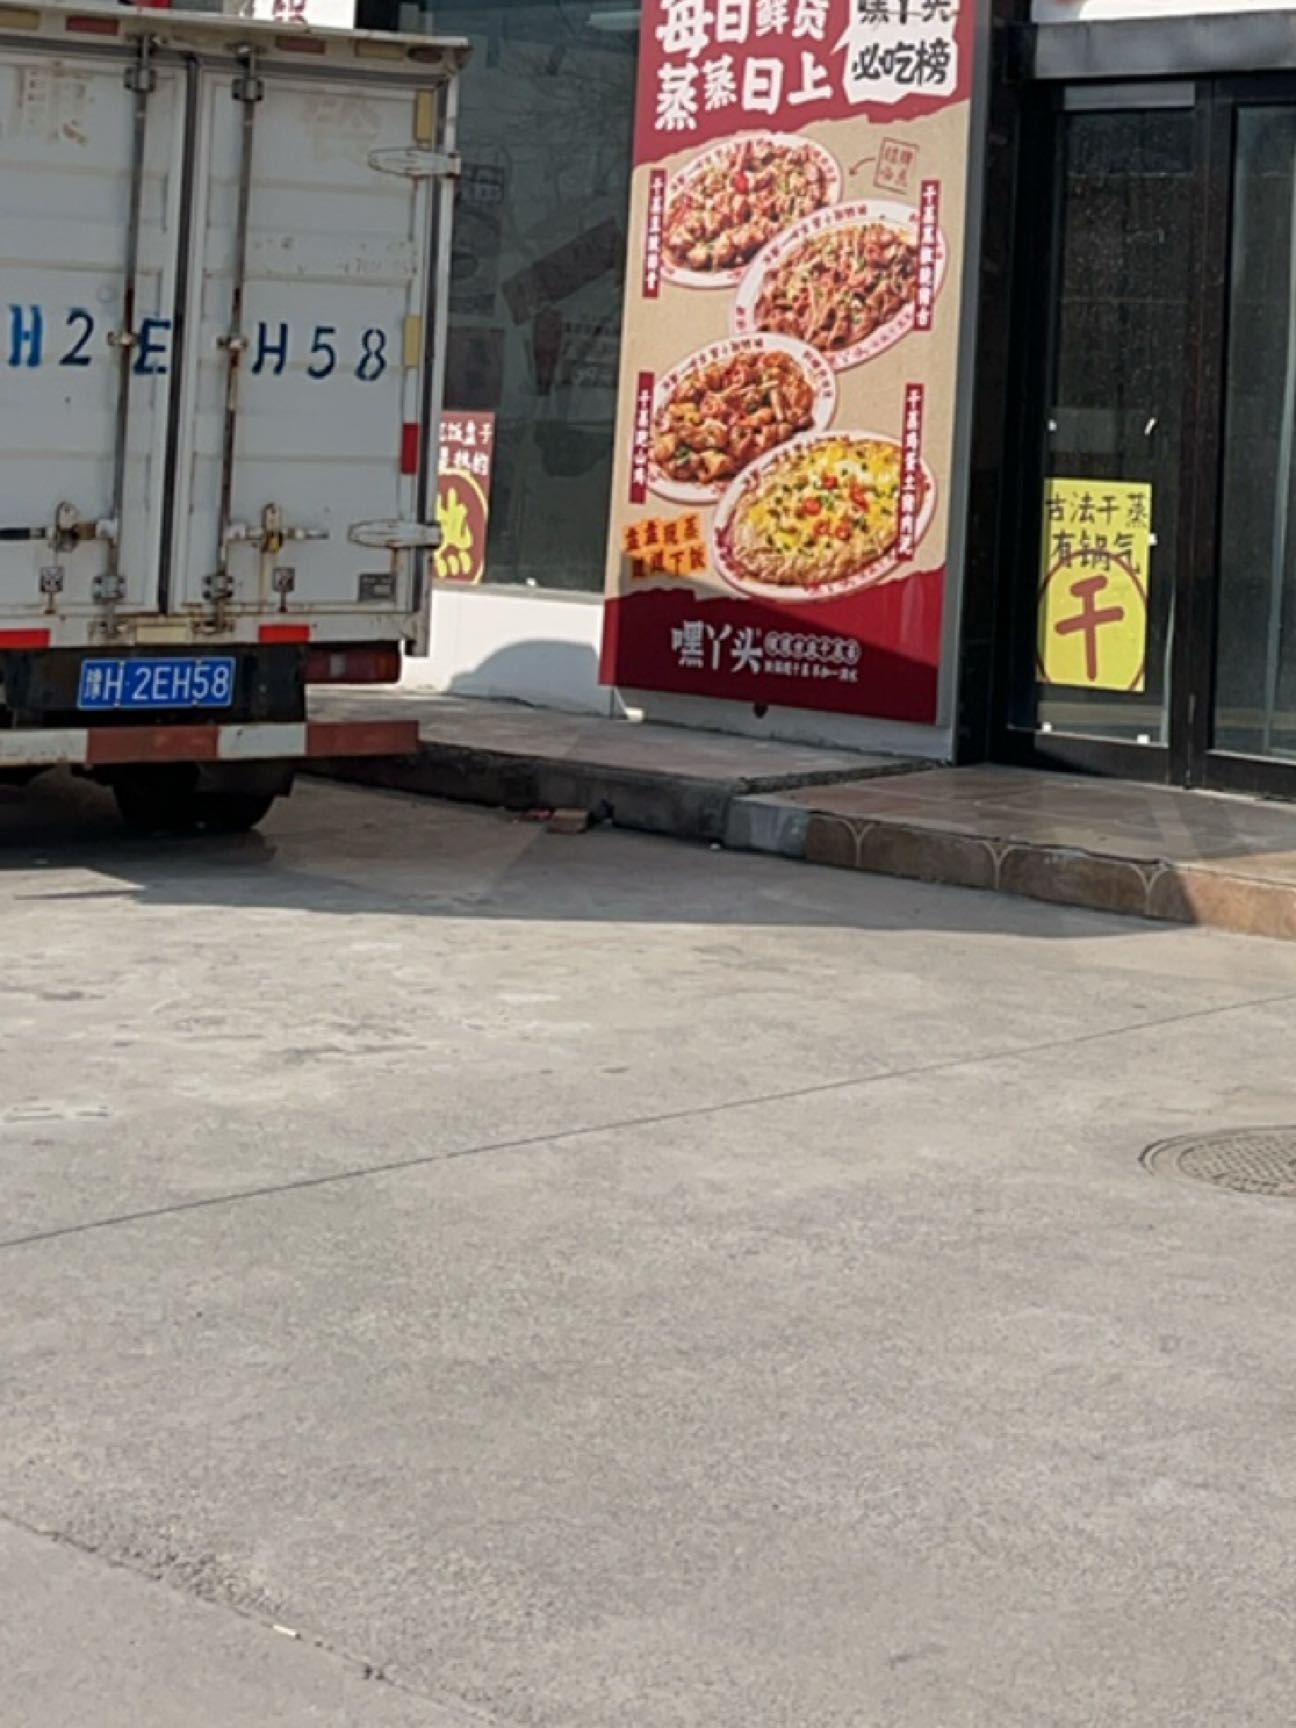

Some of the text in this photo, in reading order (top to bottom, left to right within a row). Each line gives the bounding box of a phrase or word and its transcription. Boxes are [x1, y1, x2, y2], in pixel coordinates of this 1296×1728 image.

[851, 37, 952, 87] 必吃榜
[654, 51, 834, 131] 蒸蒸日上
[1045, 490, 1148, 529] 古法干蒸
[1050, 528, 1141, 575] 有锅气
[670, 619, 764, 675] 嘿丫头
[1055, 575, 1125, 683] 干
